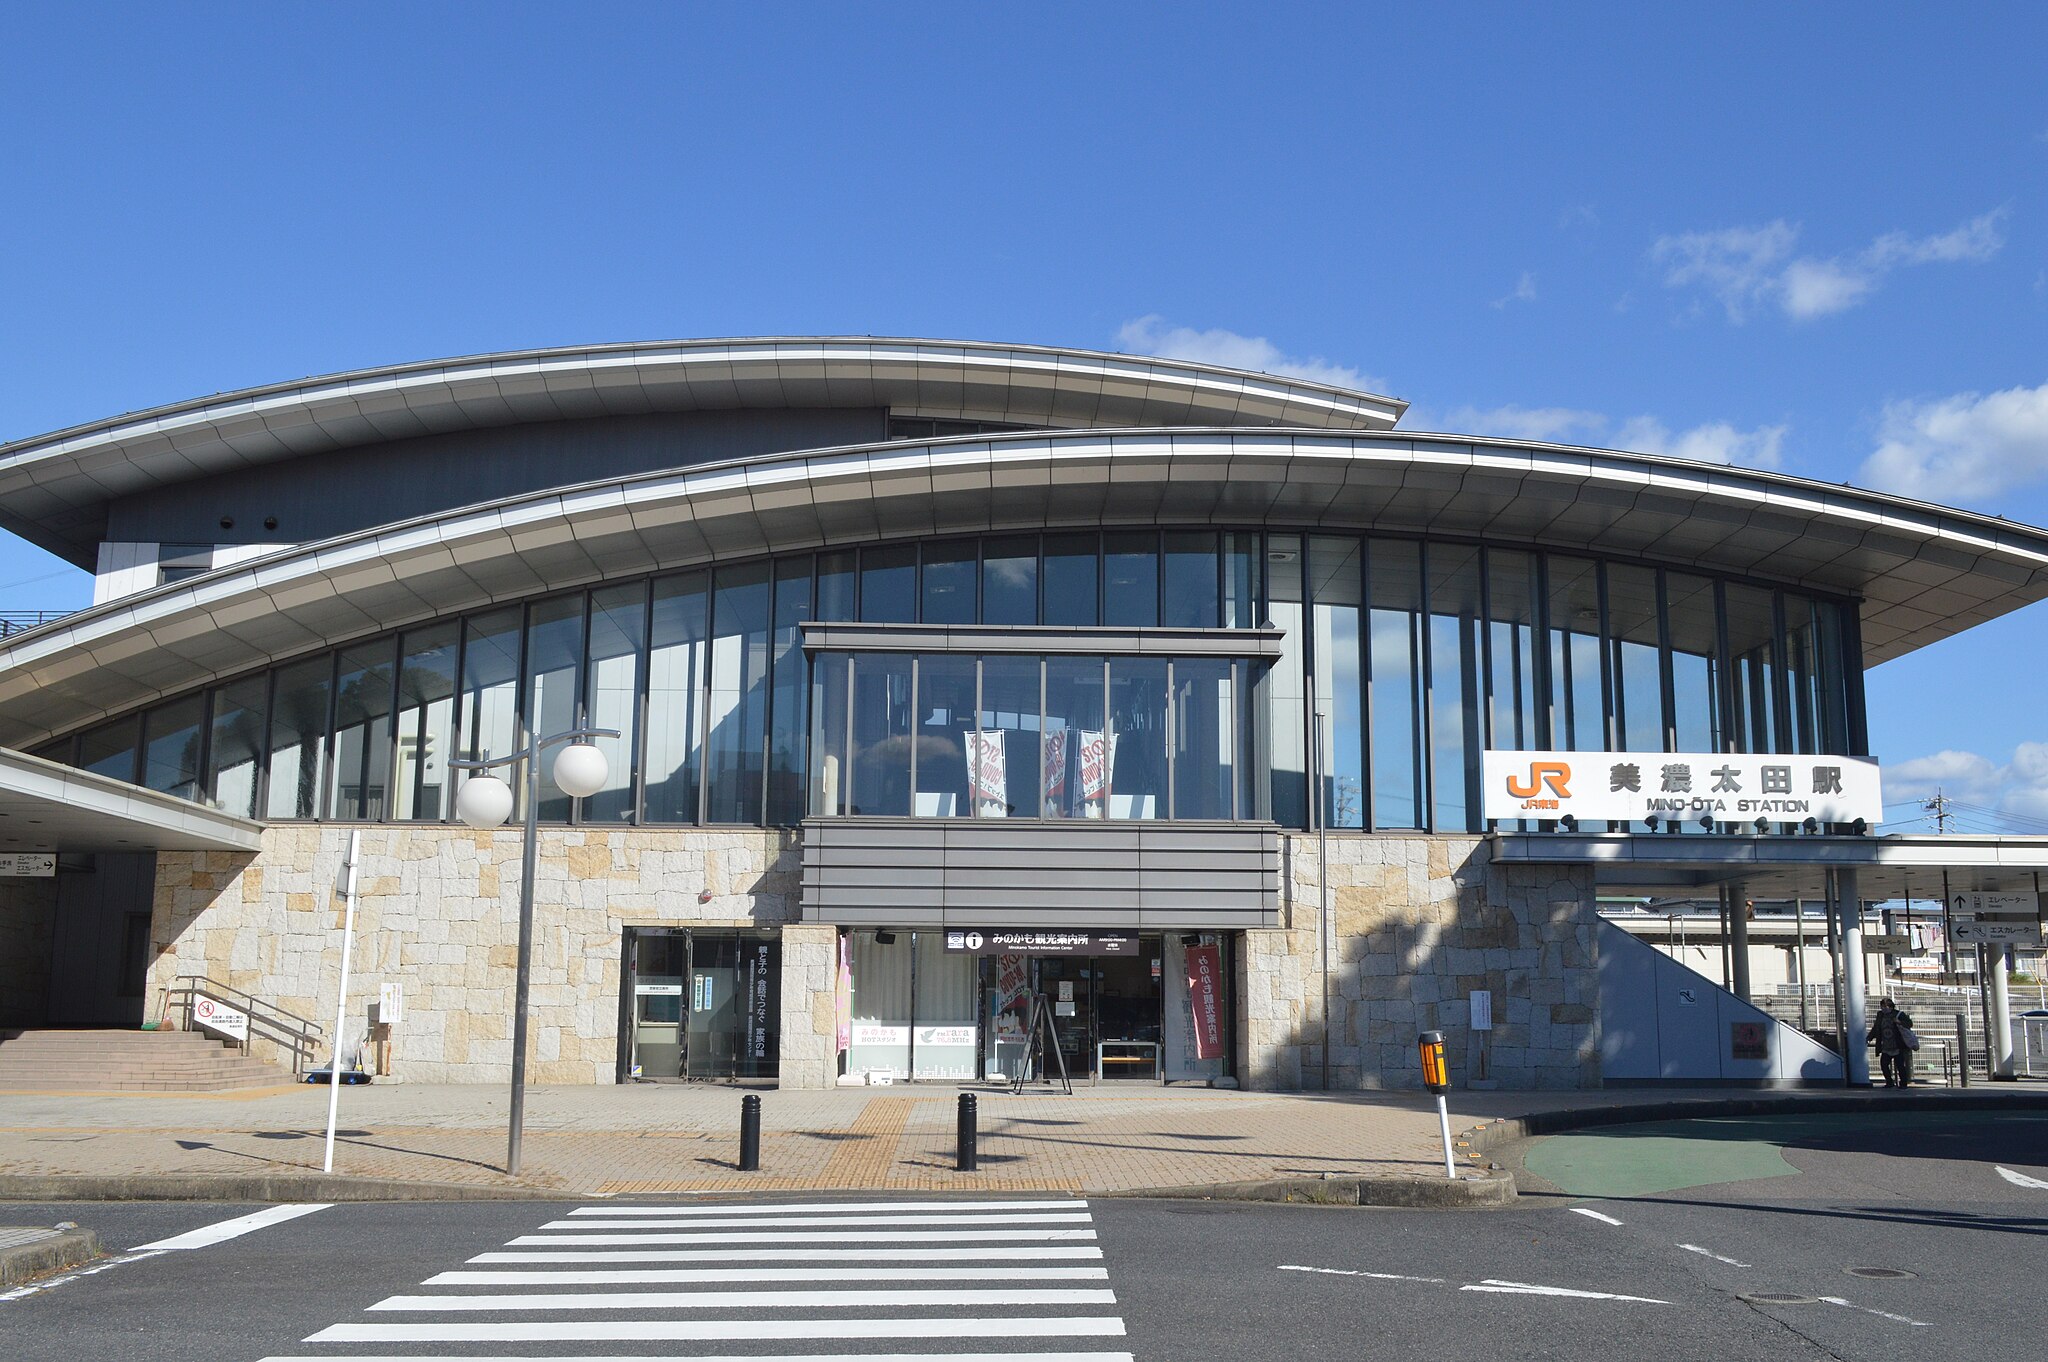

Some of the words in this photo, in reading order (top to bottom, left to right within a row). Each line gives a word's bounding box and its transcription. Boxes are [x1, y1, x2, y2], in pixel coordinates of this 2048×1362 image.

[1506, 761, 1573, 798] JR
[1609, 762, 1843, 796] 美濃太田駅
[1646, 795, 1727, 813] MINO-ŌTA
[1737, 798, 1810, 813] STATION
[1988, 896, 2028, 904] エレベーター
[1990, 926, 2036, 935] エスカレーター
[992, 933, 1089, 945] みのかも観光案内所
[861, 1028, 897, 1036] みのかも
